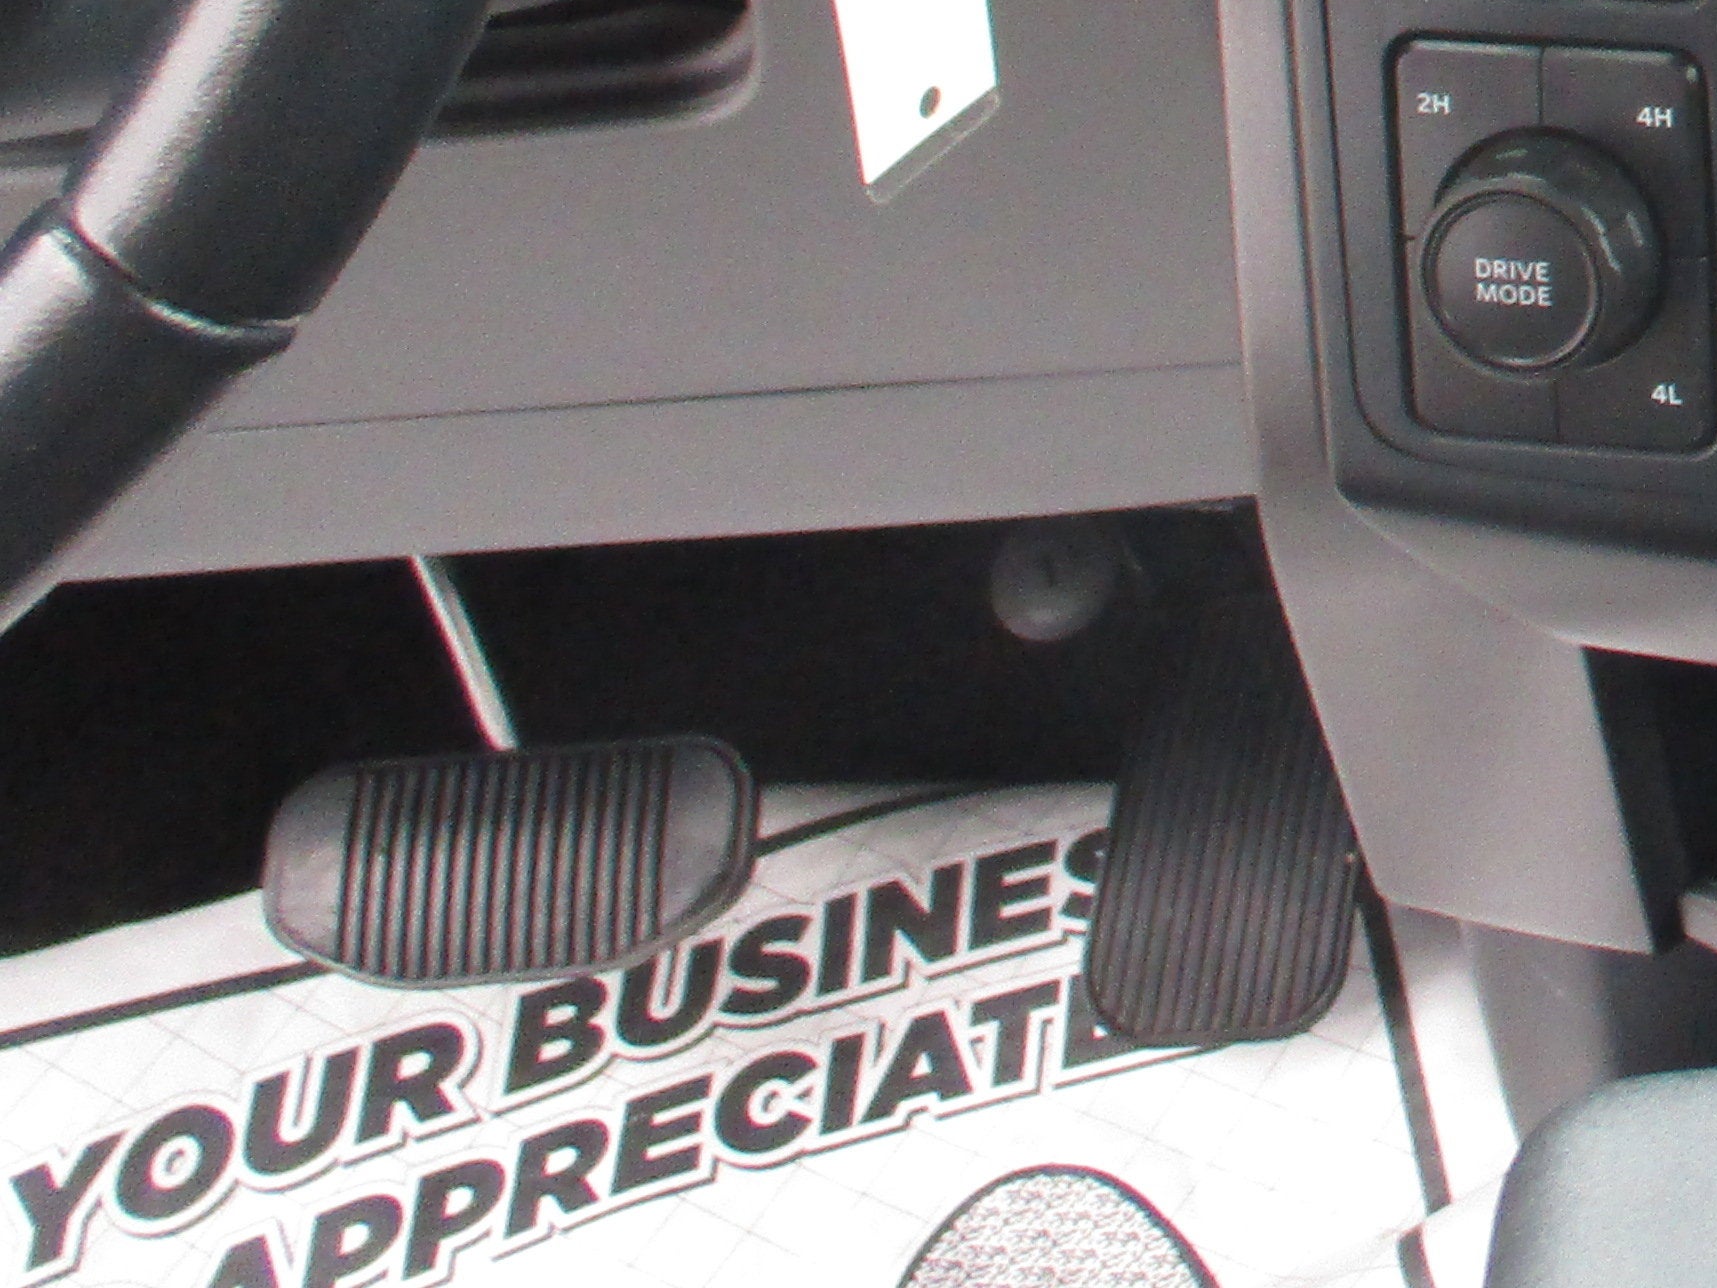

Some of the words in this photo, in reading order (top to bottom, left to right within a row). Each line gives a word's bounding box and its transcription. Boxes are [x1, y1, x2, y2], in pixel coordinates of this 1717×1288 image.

[1416, 91, 1451, 115] 2H
[1636, 106, 1673, 129] 4H
[1475, 257, 1552, 283] DRIVE
[1476, 282, 1553, 308] MODE
[1650, 383, 1683, 405] 4L
[10, 1022, 466, 1272] YOUR
